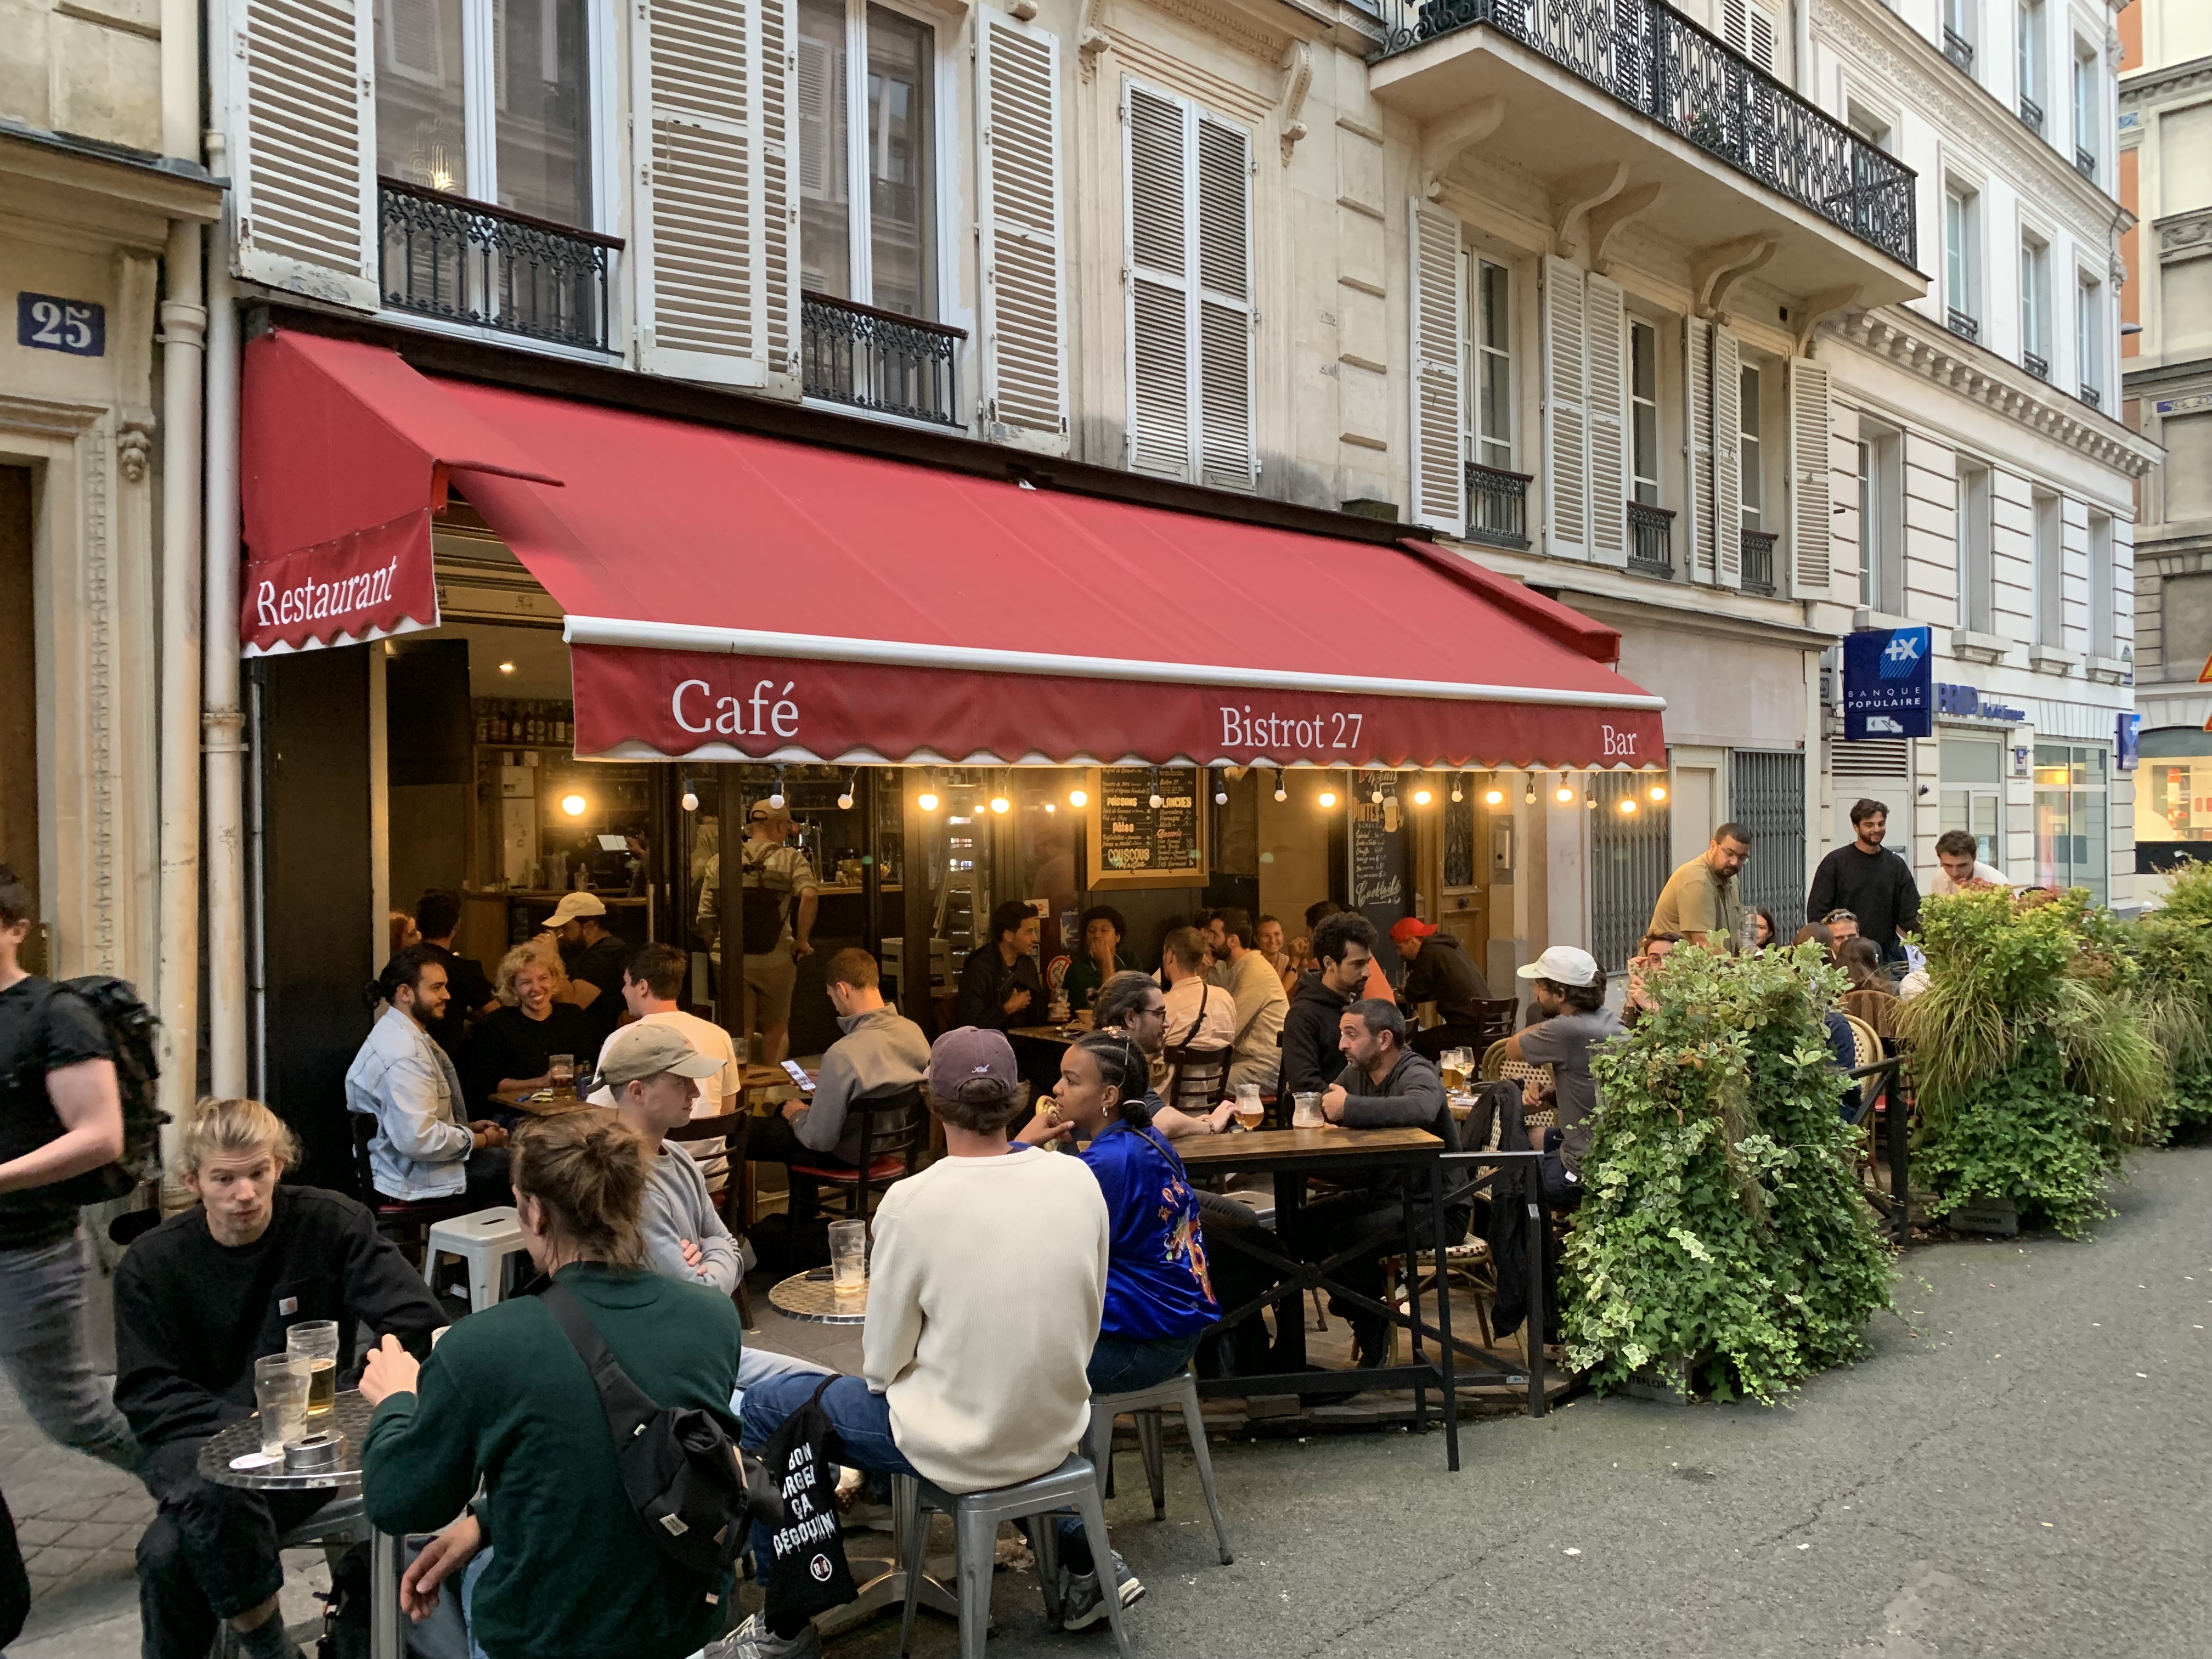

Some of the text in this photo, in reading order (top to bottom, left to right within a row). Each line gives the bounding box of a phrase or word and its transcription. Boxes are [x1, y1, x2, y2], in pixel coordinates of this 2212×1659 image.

[32, 301, 91, 348] 25
[257, 556, 397, 626] Restaurant
[672, 679, 798, 737] Café
[1848, 687, 1920, 698] BANQUE
[1848, 695, 1921, 709] POPULAIRE
[1220, 705, 1362, 748] Bistrot 27
[1601, 725, 1637, 755] Bar
[1161, 797, 1192, 808] LANCHES
[1356, 874, 1402, 908] Cocktails
[1627, 1374, 1667, 1390] ITEFLOR
